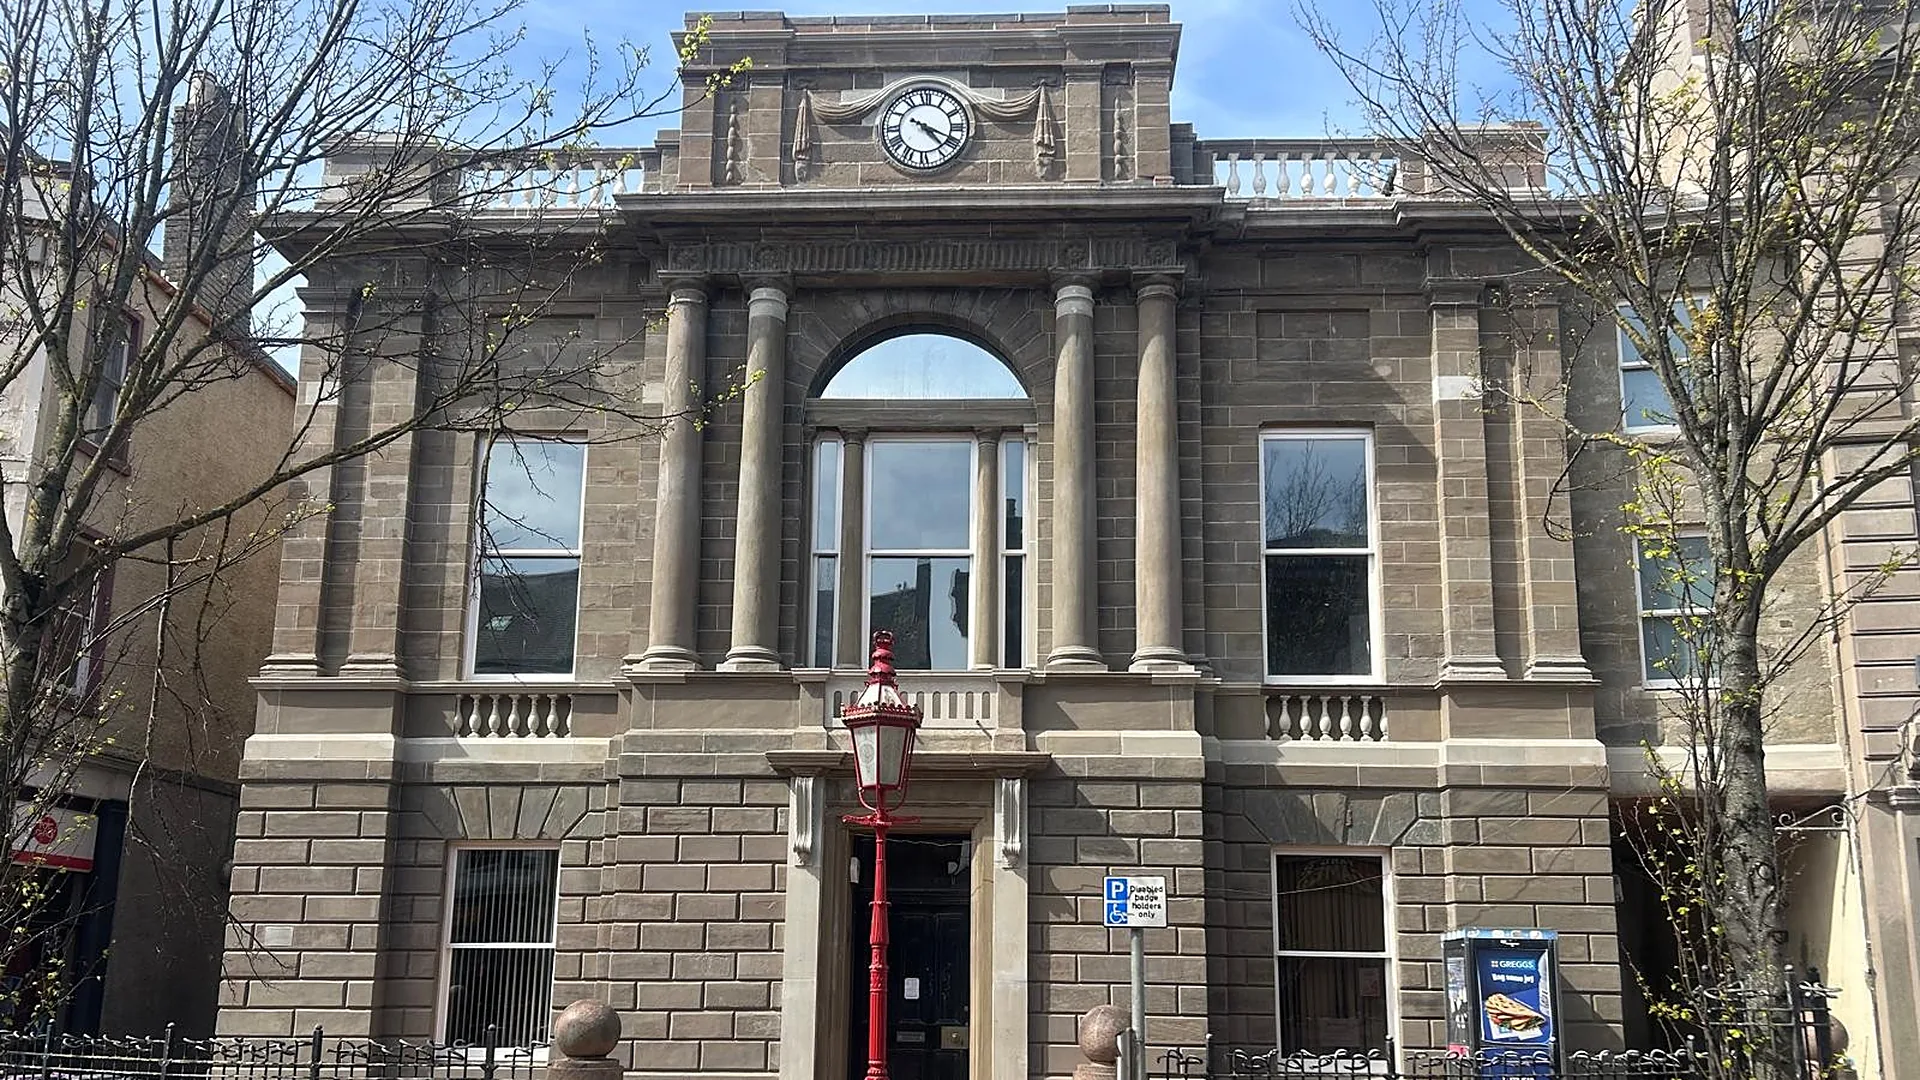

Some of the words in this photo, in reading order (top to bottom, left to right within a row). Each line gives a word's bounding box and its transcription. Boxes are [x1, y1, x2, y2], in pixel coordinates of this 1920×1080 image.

[1111, 881, 1124, 899] P
[1129, 885, 1163, 894] Disabled
[1134, 894, 1158, 902] badge
[1132, 902, 1161, 910] holders
[1138, 910, 1155, 919] only
[1499, 960, 1534, 968] GREGGS
